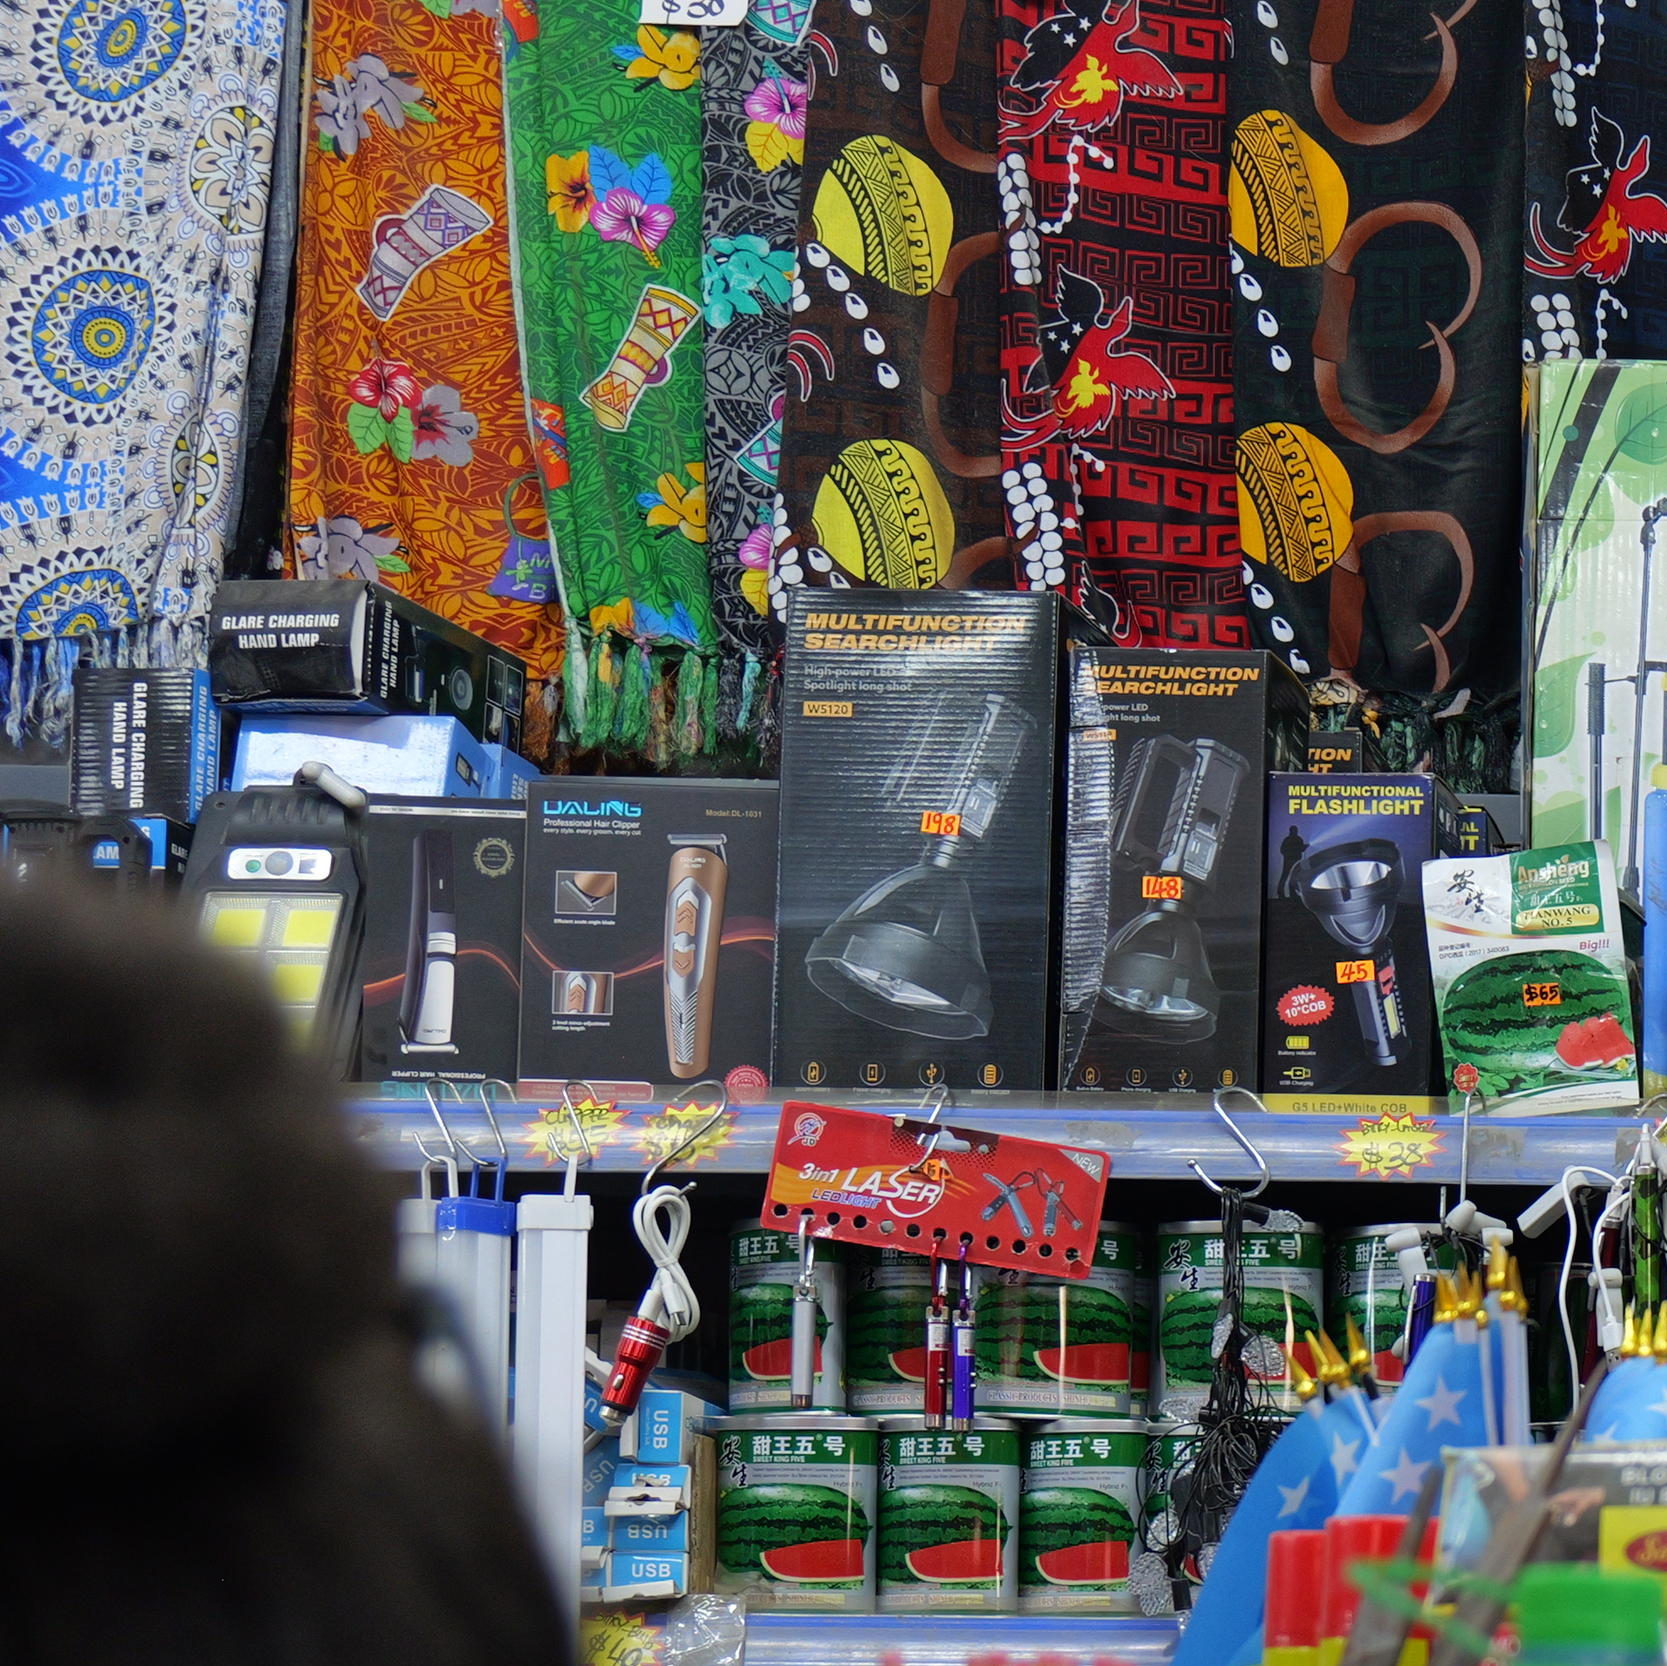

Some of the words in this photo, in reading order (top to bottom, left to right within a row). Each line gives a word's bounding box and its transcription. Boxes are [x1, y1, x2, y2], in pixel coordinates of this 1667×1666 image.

[222, 616, 265, 630] GLARE
[269, 613, 340, 629] CHARGING
[805, 613, 1026, 632] MULTIFUNCTION
[238, 634, 278, 649] HAND
[281, 633, 320, 648] LAMP
[803, 633, 999, 651] SEARCHLIGHT
[804, 664, 869, 679] High-power
[804, 679, 856, 693] Spotlight
[133, 682, 148, 728] GLARE
[112, 702, 127, 745] HAND
[110, 747, 126, 790] LAMP
[129, 731, 146, 809] CHARGING
[1287, 785, 1424, 798] MULTIFUNCTIONAL
[544, 801, 643, 818] DALING
[1287, 799, 1424, 816] FLASHLIGHT
[543, 818, 591, 829] Professional
[924, 812, 956, 834] 198
[1142, 876, 1181, 899] 148
[1579, 938, 1610, 953] Big!!!
[1340, 963, 1370, 981] 45
[1292, 1101, 1310, 1113] G5
[1311, 1101, 1378, 1113] LED+White
[1380, 1101, 1408, 1113] COB
[1072, 1153, 1100, 1176] NEW
[799, 1162, 840, 1184] 3in1
[841, 1165, 943, 1205] LASER
[812, 1188, 882, 1209] LEDLIGHT
[653, 1409, 669, 1450] USB
[752, 1435, 846, 1457] 甜王五号
[899, 1436, 985, 1458] 甜王五号
[627, 1524, 668, 1539] USB
[631, 1562, 672, 1578] USB
